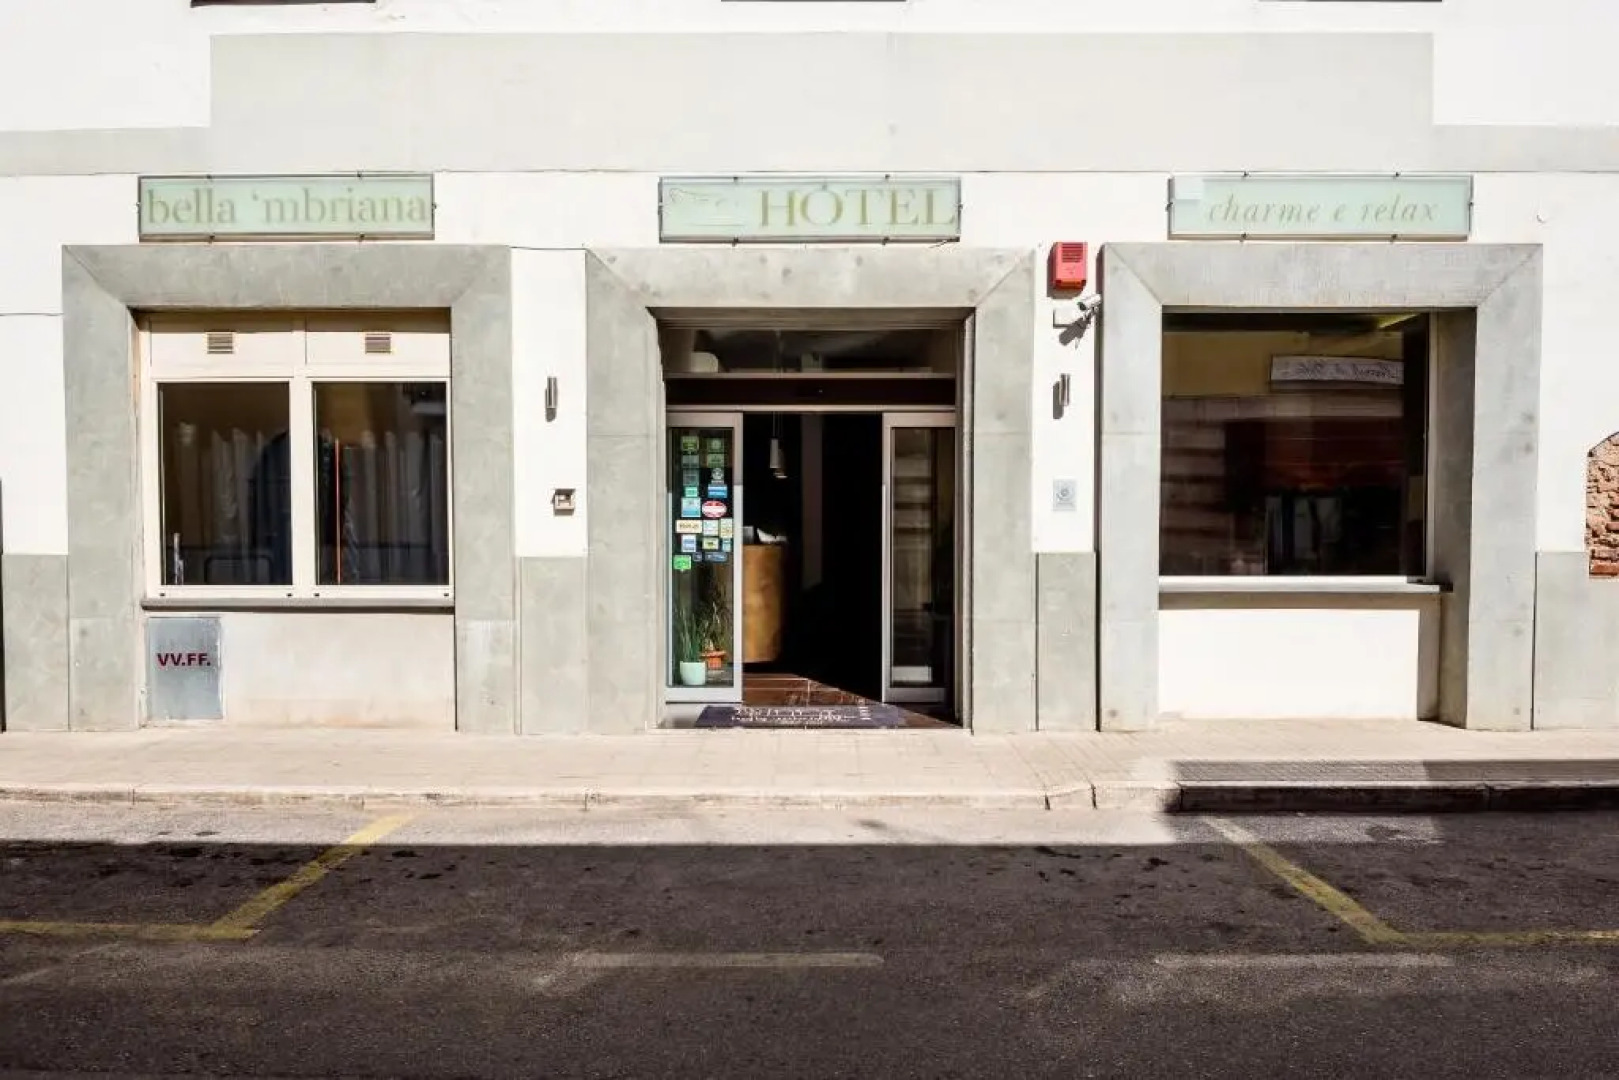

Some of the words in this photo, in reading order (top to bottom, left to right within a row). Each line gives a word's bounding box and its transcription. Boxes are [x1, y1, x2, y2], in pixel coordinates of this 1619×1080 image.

[147, 187, 235, 224] bella
[760, 188, 956, 227] HOTEL
[1208, 194, 1320, 223] charme
[1333, 202, 1346, 222] e
[1361, 194, 1438, 223] relax
[157, 652, 211, 667] VV.FF.
